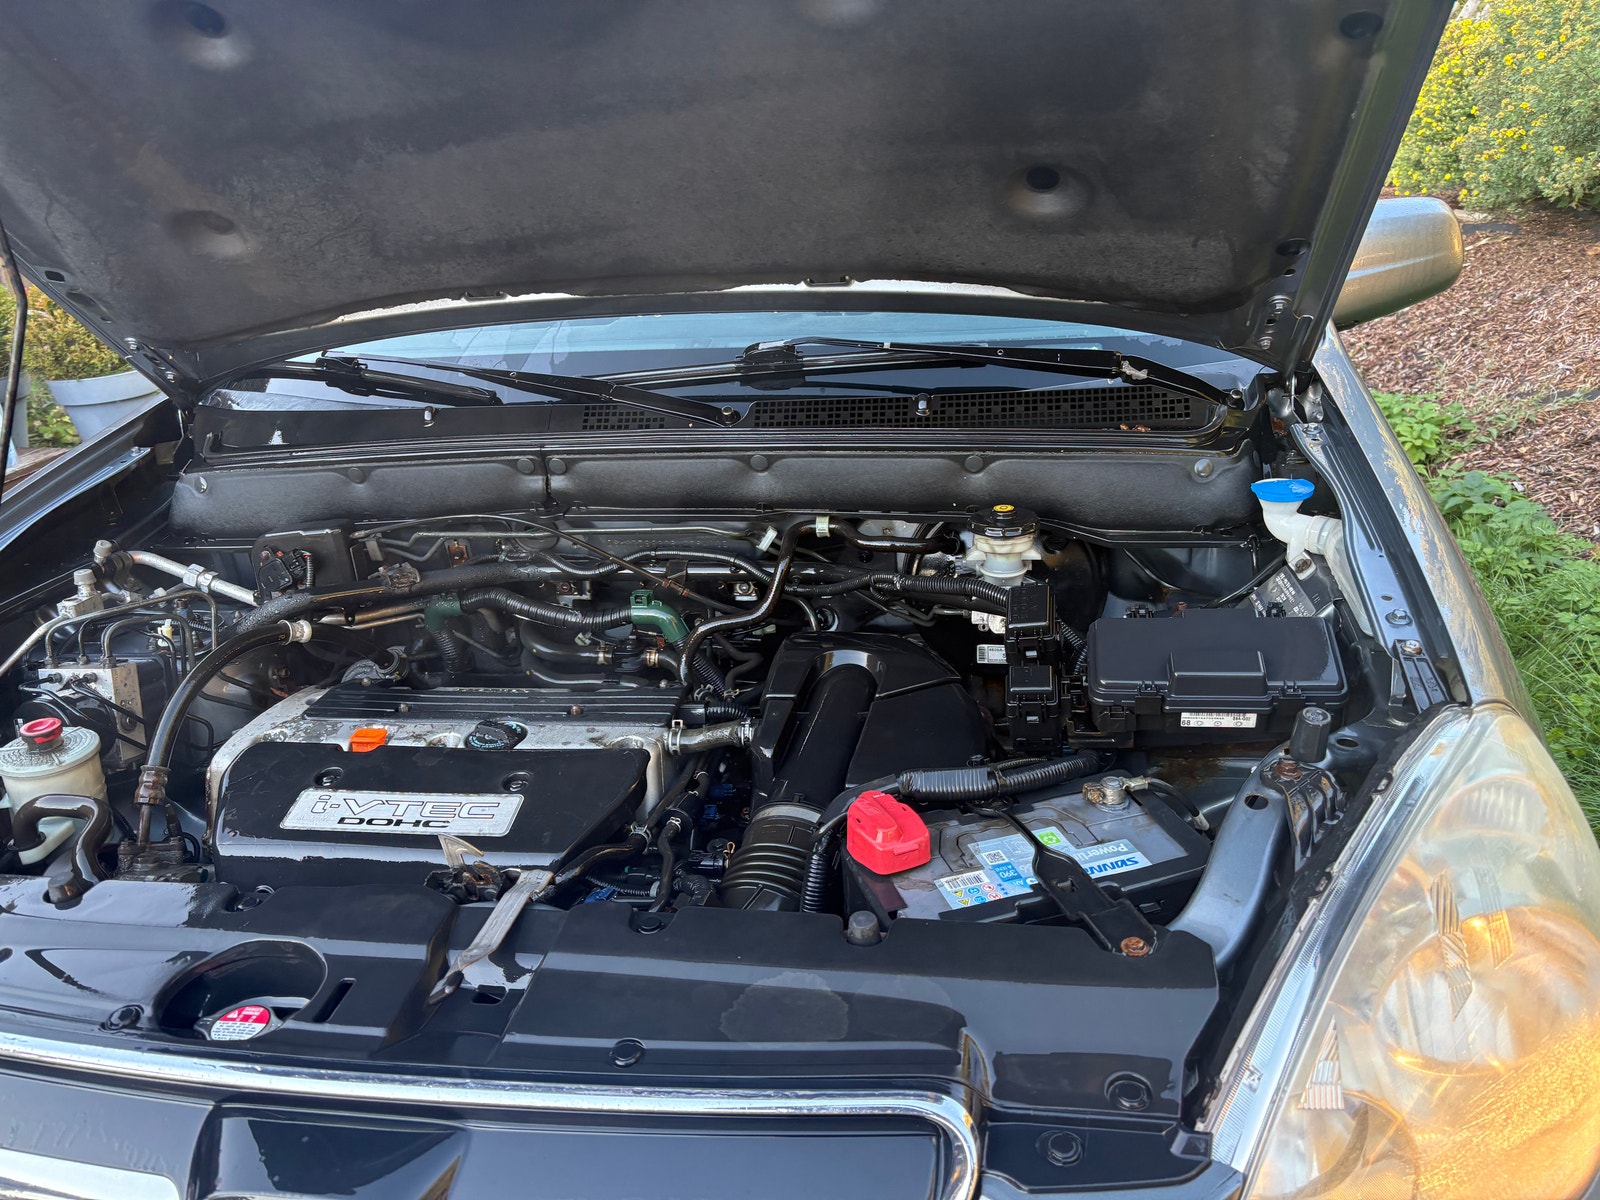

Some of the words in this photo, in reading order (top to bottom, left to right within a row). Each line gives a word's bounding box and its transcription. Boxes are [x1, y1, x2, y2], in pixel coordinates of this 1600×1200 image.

[311, 794, 501, 820] i-VTEC
[337, 816, 451, 829] DOHC
[999, 869, 1018, 879] 390
